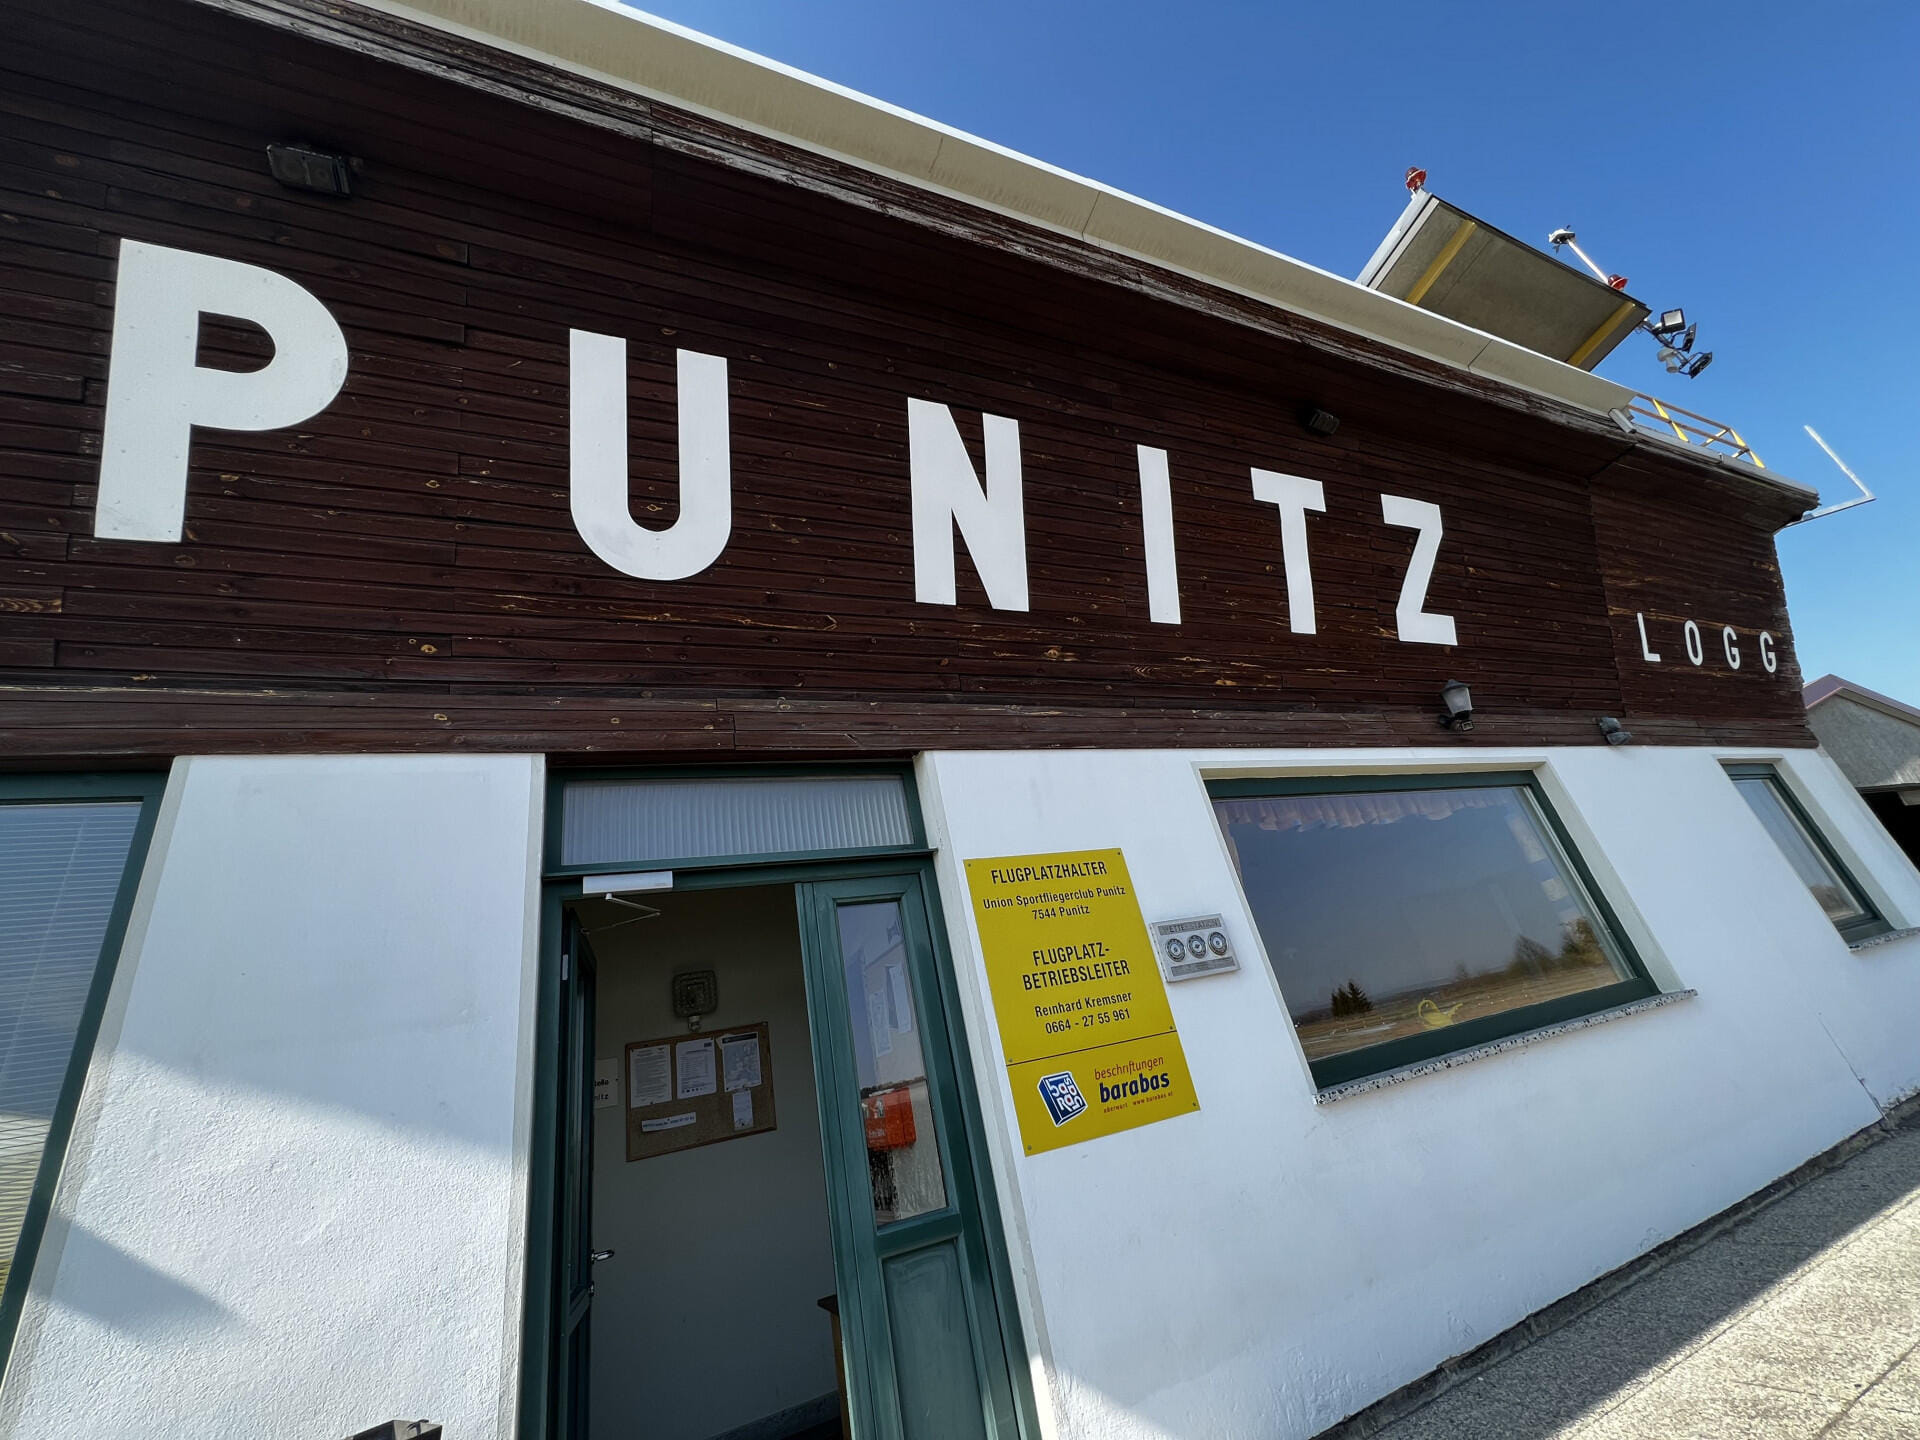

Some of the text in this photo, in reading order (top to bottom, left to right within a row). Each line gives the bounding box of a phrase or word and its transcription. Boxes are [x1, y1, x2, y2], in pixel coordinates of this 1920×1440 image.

[94, 238, 1458, 646] PUNITZ
[1637, 612, 1777, 673] LOGG
[991, 861, 1108, 884] FLUGPLATZHALTER
[983, 885, 1126, 909] Union Sportfliegerclub Punitz
[1032, 904, 1090, 920] 7544 Punitz
[1033, 942, 1110, 966] FLUGPLATZ-
[1022, 960, 1130, 991] BETRIEBSLEITER
[1035, 992, 1132, 1017] Reinhard Kremsner
[1045, 1019, 1071, 1034] 0664
[1082, 1014, 1095, 1027] 27
[1097, 1011, 1111, 1025] 55
[1112, 1008, 1131, 1022] 961
[1094, 1056, 1164, 1080] beschriftungen
[1099, 1072, 1170, 1103] barabas
